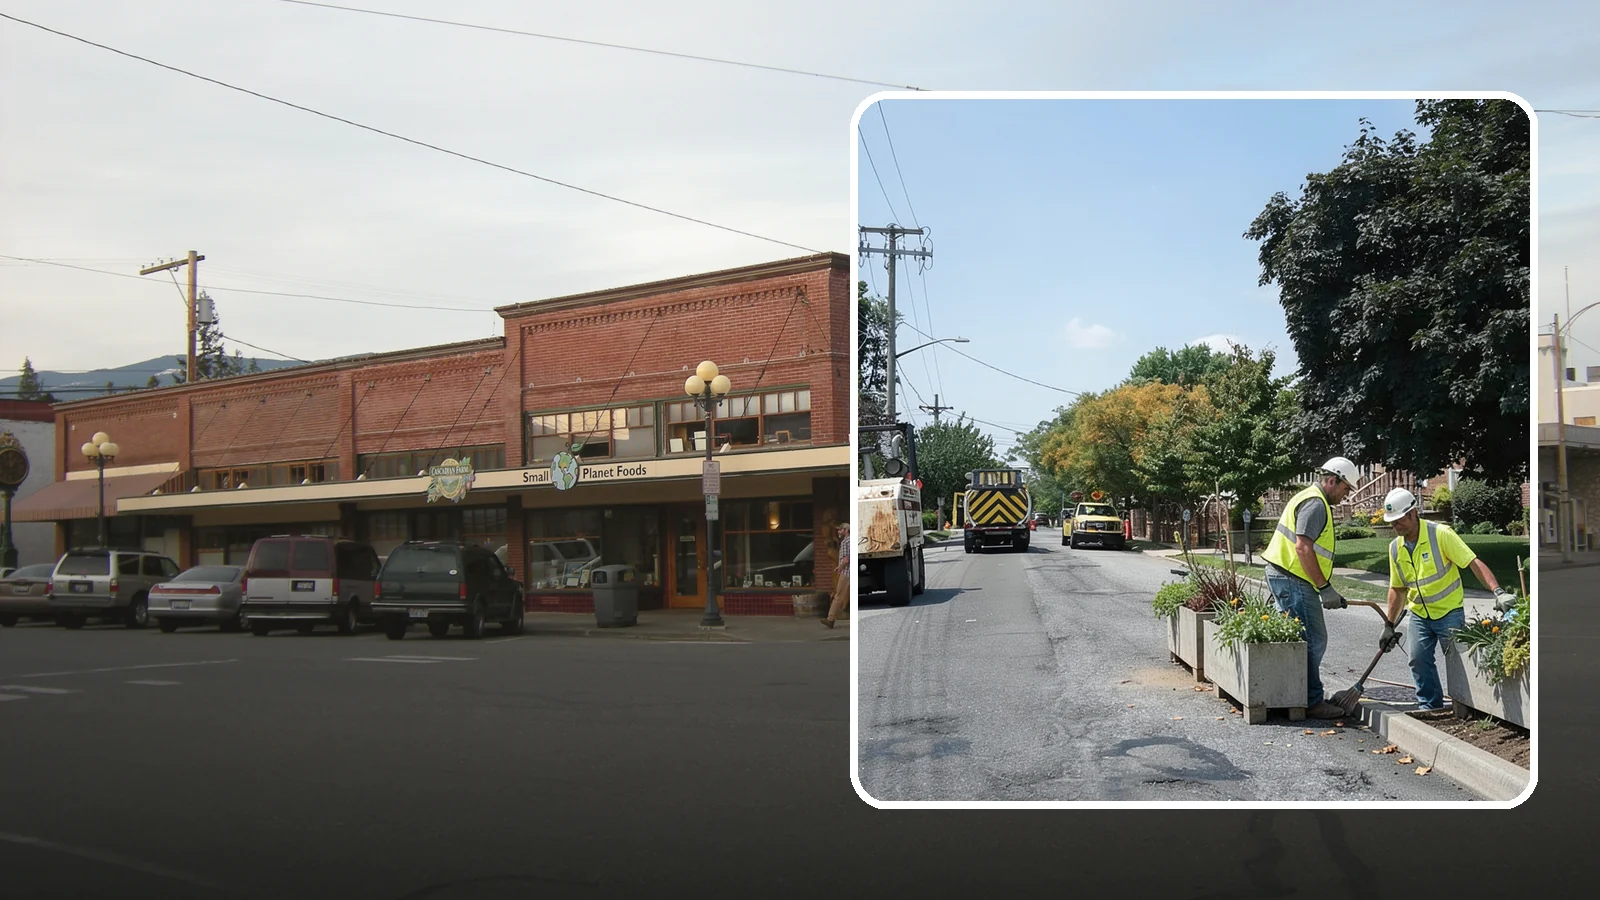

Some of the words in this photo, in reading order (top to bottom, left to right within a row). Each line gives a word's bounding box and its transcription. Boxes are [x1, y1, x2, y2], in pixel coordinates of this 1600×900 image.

[523, 471, 549, 482] Small
[582, 467, 614, 479] Planet
[616, 464, 647, 477] Foods
